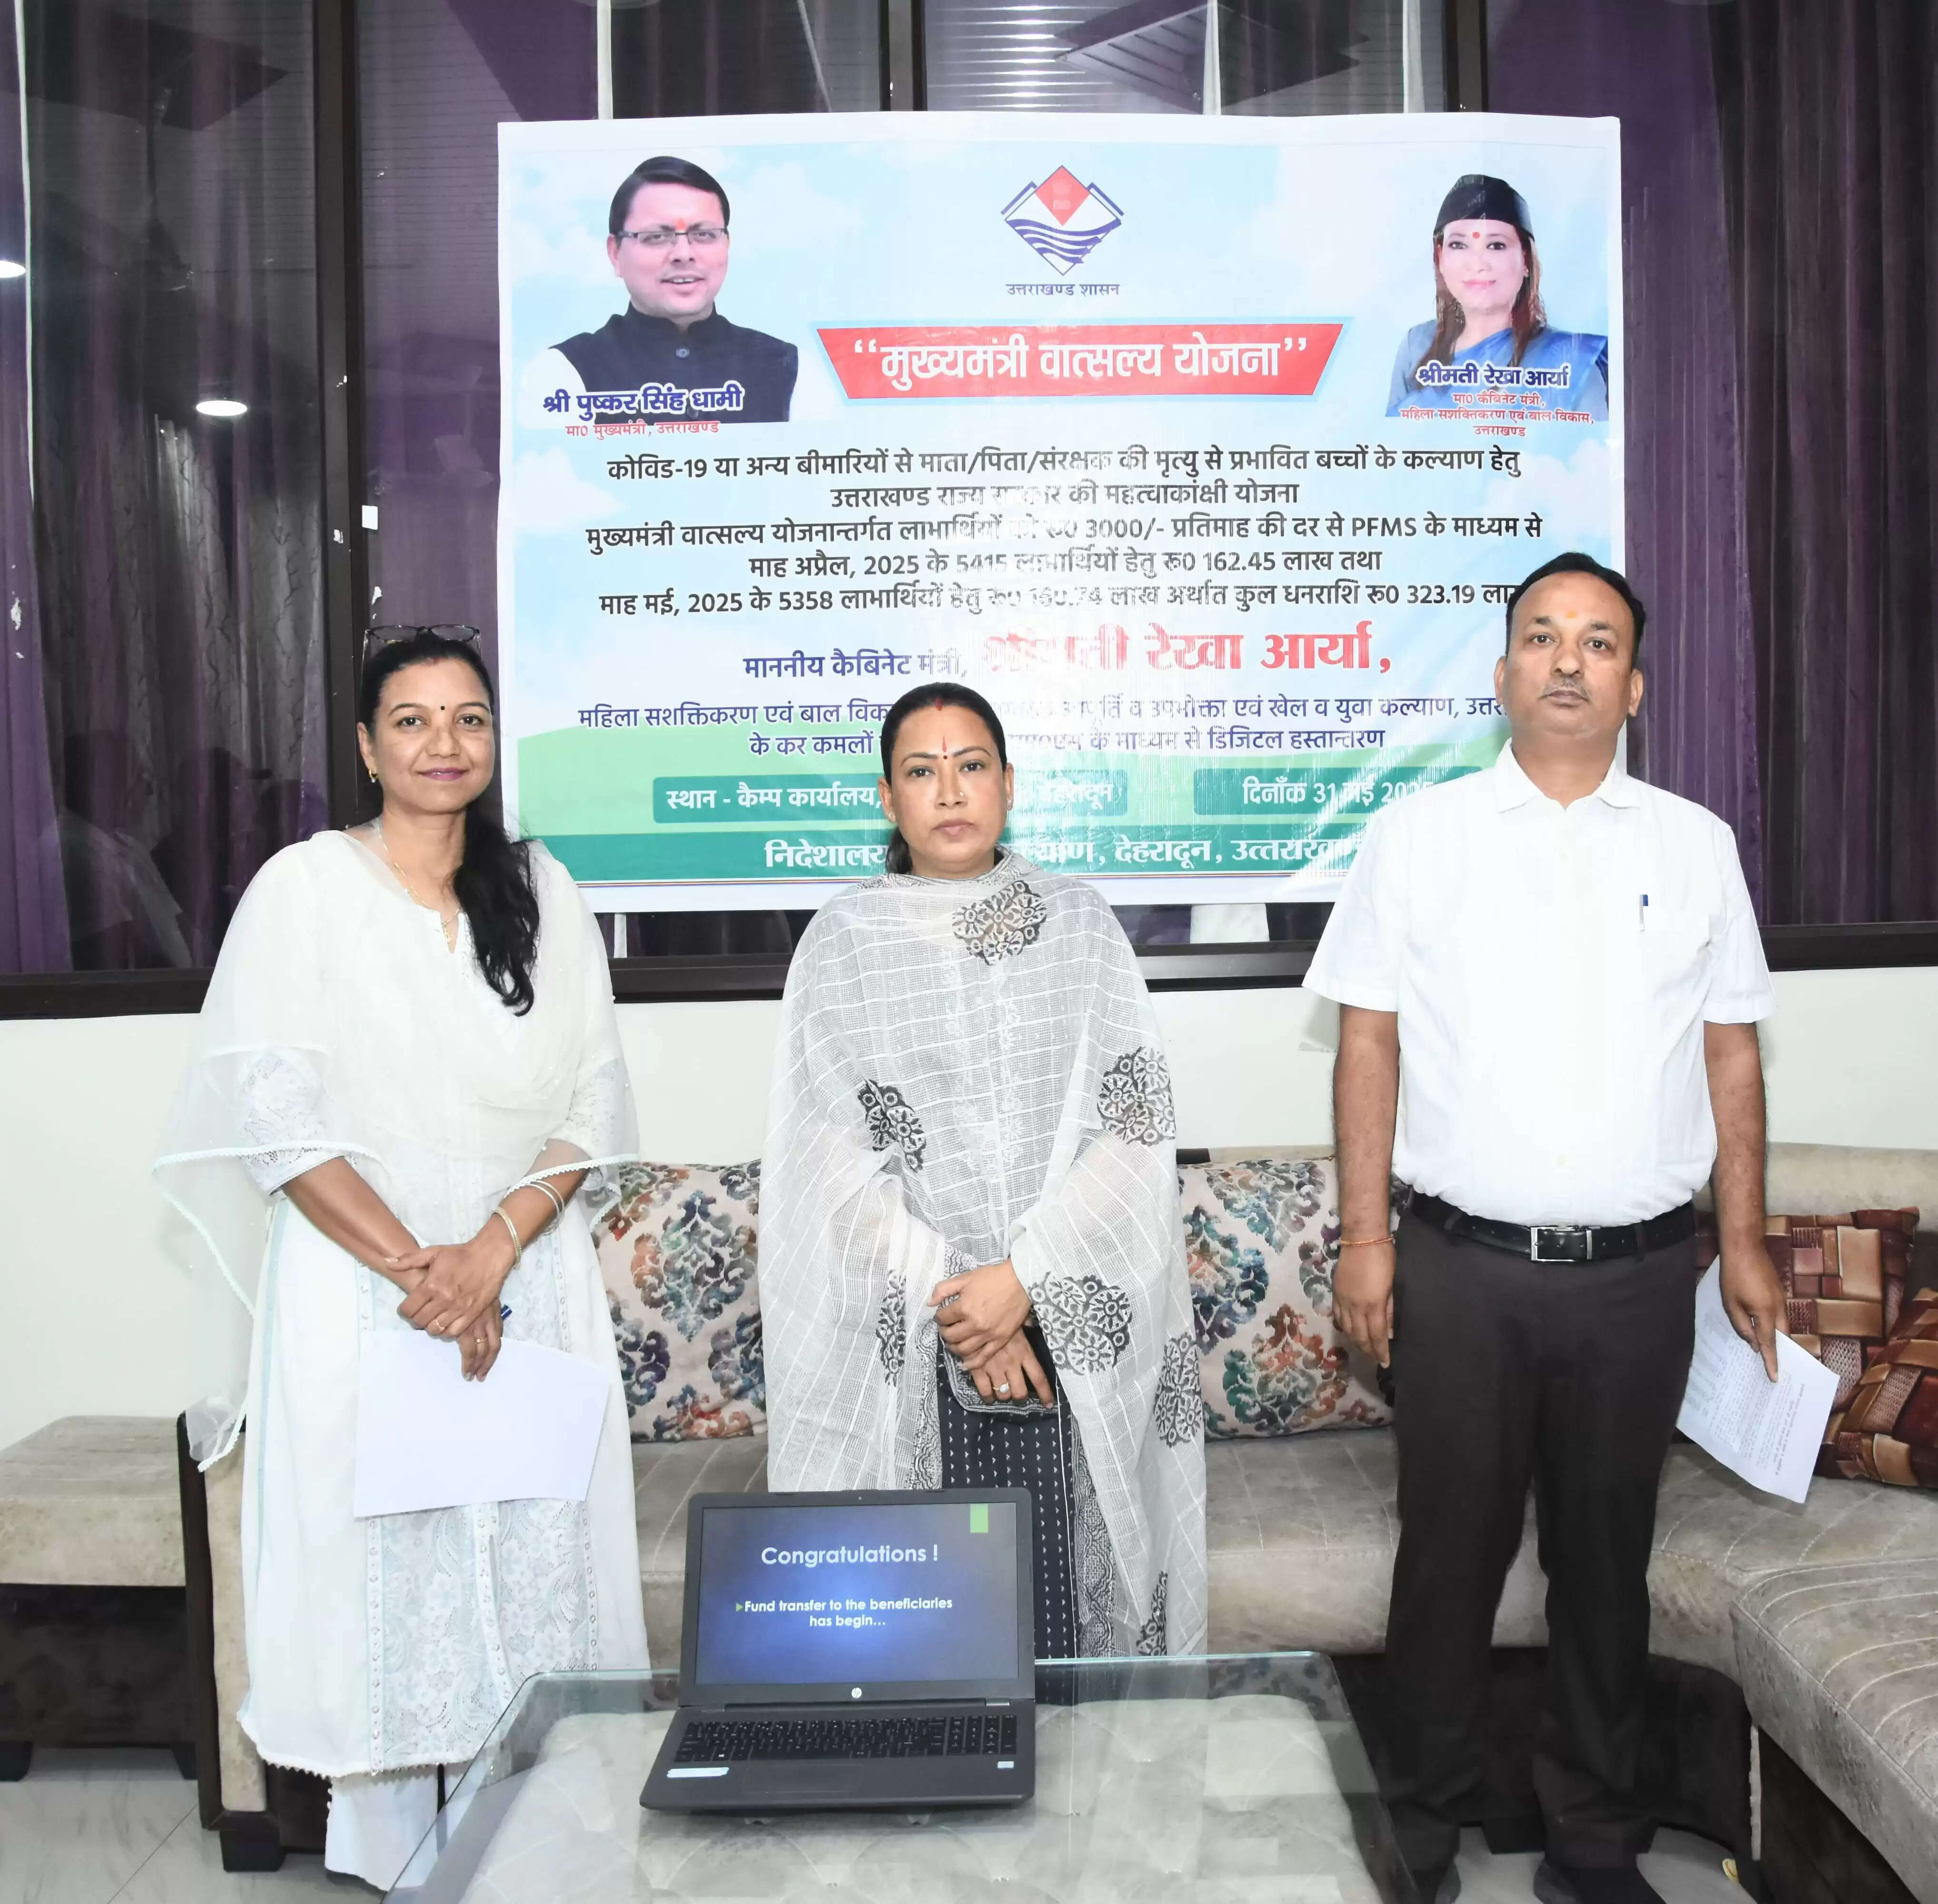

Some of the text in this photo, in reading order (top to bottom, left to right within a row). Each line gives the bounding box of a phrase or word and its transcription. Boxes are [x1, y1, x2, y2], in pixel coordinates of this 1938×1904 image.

[1005, 284, 1120, 297] उत्तराखण्ड शासन
[1039, 341, 1164, 378] वात्सल्य
[1418, 363, 1568, 386] श्रीमती रेखा आर्या
[543, 383, 742, 420] श्री पुष्कर सिंह धामी
[1477, 389, 1516, 405] कैबिनेट
[655, 420, 721, 434] उत्तराखण्ड
[1401, 406, 1594, 425] महिला सशक्तिकरण एवं बाल विकास,
[1473, 425, 1526, 436] उत्तराखण्ड
[607, 444, 1522, 480] कोविड-19 या अन्य बीमारियों से माता/पिता/संरक्षक की मृत्यु से प्रभावित बच्चों के कल्याण हेतु
[830, 487, 931, 508] उत्तराखण्ड
[937, 486, 986, 506] राज्य
[1068, 478, 1099, 505] की
[1104, 477, 1227, 505] महत्वाकांक्षी
[1235, 478, 1300, 504] योजना
[586, 520, 674, 555] मुख्यमंत्री
[681, 524, 765, 545] वात्सल्य
[772, 518, 893, 545] योजनान्तर्गत
[898, 511, 1003, 541] लाभार्थियों
[1086, 517, 1164, 540] 3000/-
[1171, 513, 1250, 538] प्रतिमाह
[1256, 511, 1287, 537] की
[1293, 517, 1319, 538] दर
[1326, 511, 1344, 537] से
[1352, 518, 1416, 537] PFMS
[1424, 511, 1447, 537] के
[1453, 518, 1519, 537] माध्यम
[1523, 512, 1542, 537] से
[748, 556, 786, 578] माह
[794, 549, 857, 578] अप्रैल,
[863, 555, 919, 575] 2025
[926, 548, 949, 573] के
[957, 554, 1008, 573] 5415
[1014, 544, 1119, 573] लाभार्थियों
[1123, 546, 1157, 579] हेतु
[1203, 551, 1276, 571] 162.45
[1282, 552, 1332, 571] लाख
[1339, 552, 1382, 570] तथा
[600, 594, 636, 615] माह
[643, 586, 679, 616] मई,
[688, 593, 743, 613] 2025
[750, 585, 772, 611] के
[779, 590, 833, 610] 5358
[839, 579, 943, 609] लाभार्थियों
[949, 582, 982, 615] हेतु
[1108, 585, 1159, 605] लाख
[1166, 579, 1228, 604] अर्थात
[1235, 585, 1277, 612] कुल
[1283, 577, 1360, 605] धनराशि
[1407, 585, 1475, 604] 323.19
[1481, 585, 1523, 603] ला
[742, 650, 825, 678] माननीय
[831, 647, 911, 676] कैबिनेट
[1144, 622, 1244, 670] रेखा
[1260, 620, 1391, 674] आर्या,
[578, 704, 639, 728] महिला
[645, 702, 757, 725] सशक्तिकरण
[764, 701, 794, 724] एवं
[799, 704, 840, 723] बाल
[847, 698, 894, 723] विक
[1129, 700, 1142, 718] व
[1234, 694, 1263, 718] एवं
[1269, 695, 1305, 718] खेल
[1314, 699, 1330, 717] व
[1335, 699, 1372, 723] युवा
[1378, 698, 1459, 718] कल्याण,
[749, 732, 769, 755] के
[775, 736, 806, 755] कर
[812, 730, 874, 754] कमलों
[1090, 726, 1110, 750] के
[1115, 732, 1179, 750] माध्यम
[1184, 725, 1202, 750] से
[1207, 725, 1281, 750] डिजिटल
[1290, 730, 1385, 750] हस्तान्तरण
[666, 790, 717, 809] स्थान
[736, 782, 783, 807] कैम्प
[787, 781, 881, 809] कार्यालय,
[1243, 774, 1434, 807] दिनाँक 31 मई 20
[764, 839, 889, 868] निदेशालय
[1230, 839, 1362, 861] उत्तराख
[761, 1545, 939, 1567] Congratulations !
[745, 1597, 952, 1612] Fund transfer to the beneficiaries
[810, 1615, 831, 1626] has
